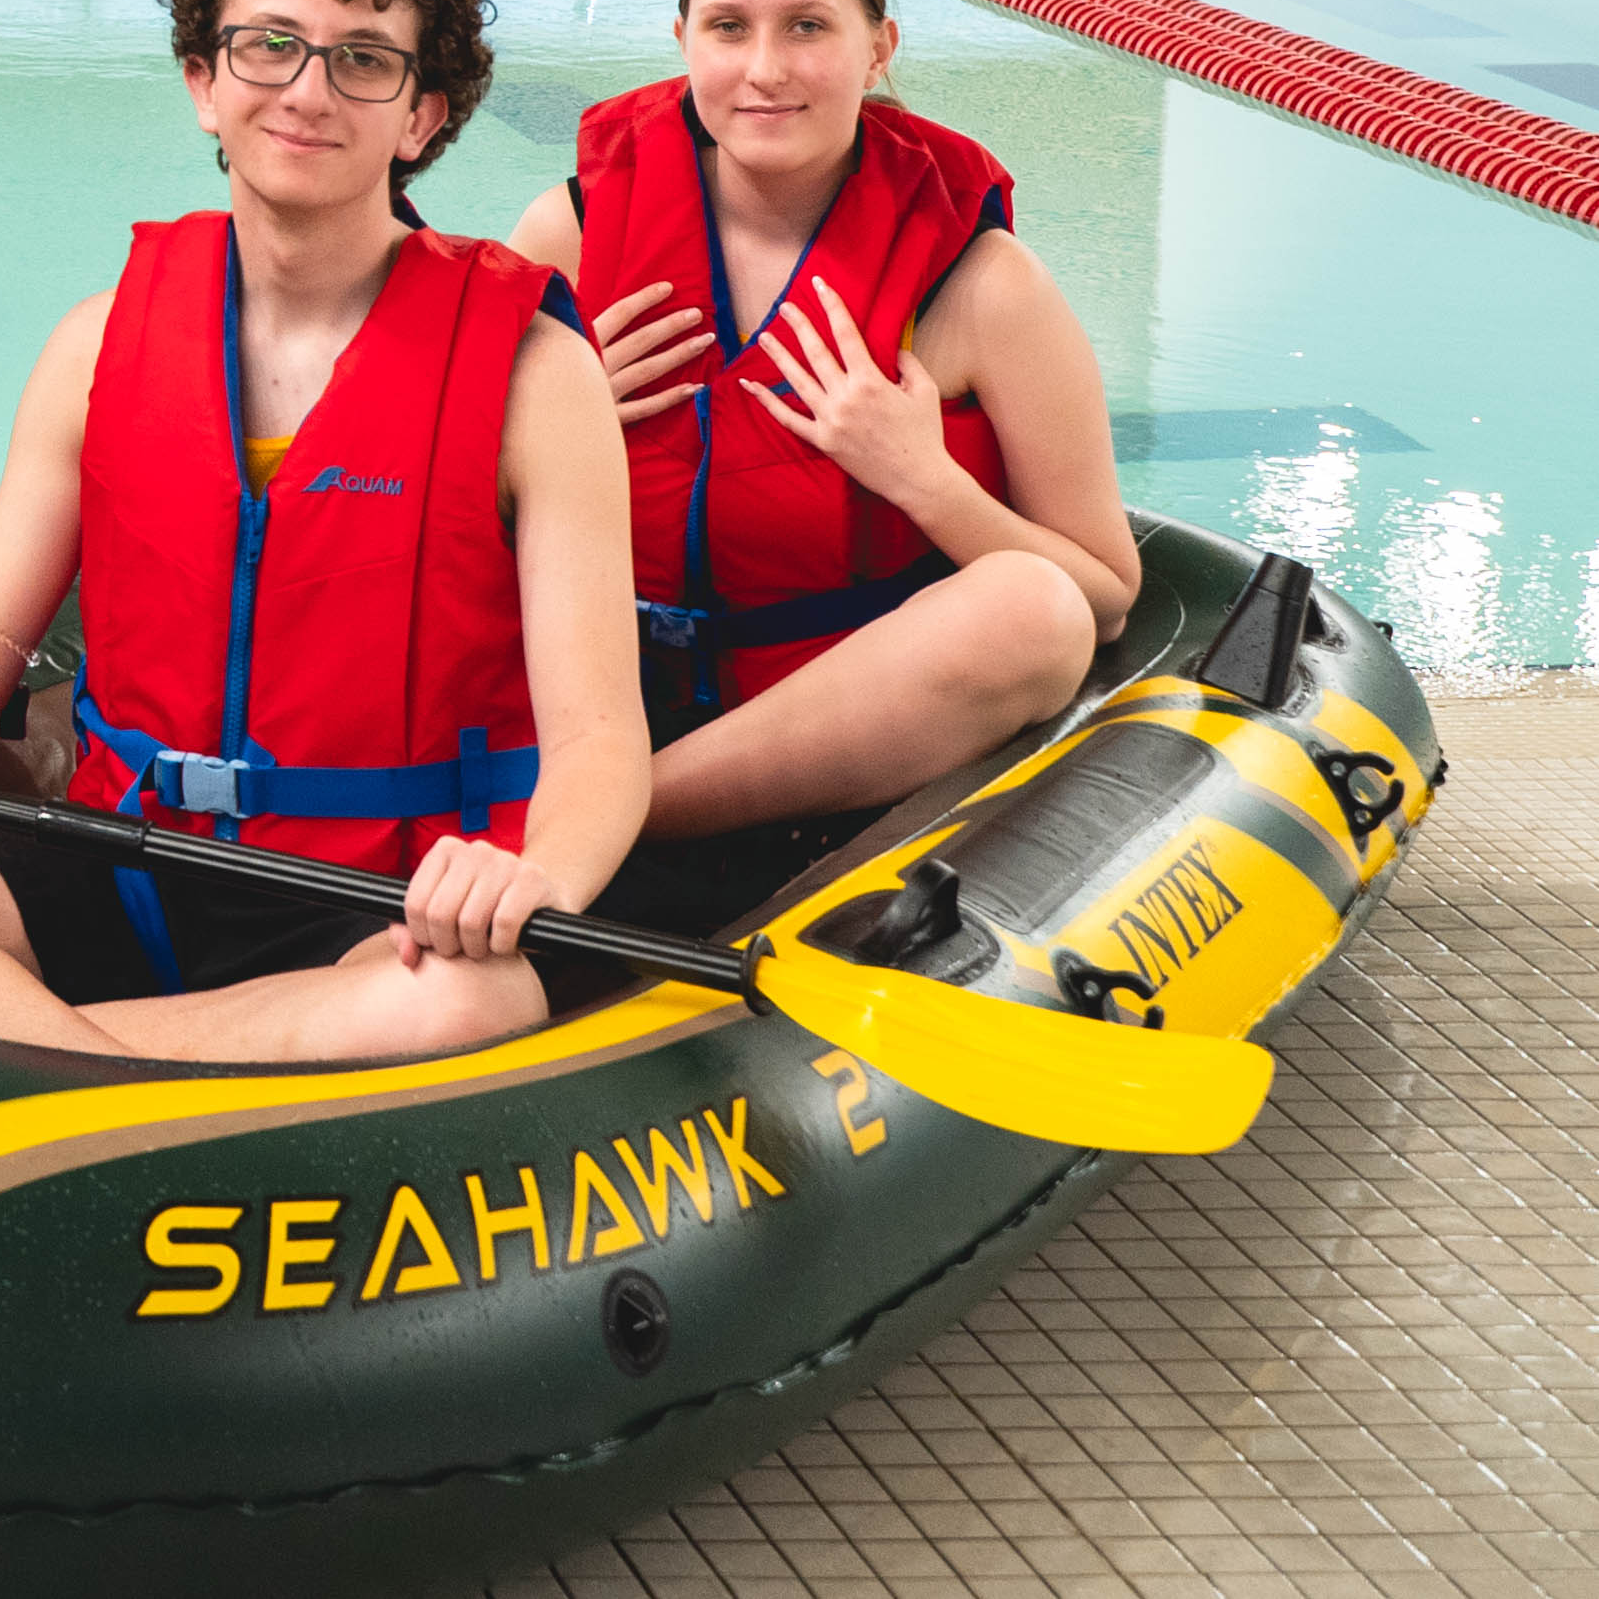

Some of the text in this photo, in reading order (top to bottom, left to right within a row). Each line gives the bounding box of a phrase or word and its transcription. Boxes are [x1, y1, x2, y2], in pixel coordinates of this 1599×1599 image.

[301, 465, 404, 496] AQUAM
[1107, 837, 1244, 996] INTEX
[134, 1047, 889, 1319] SEAHAWK 2
